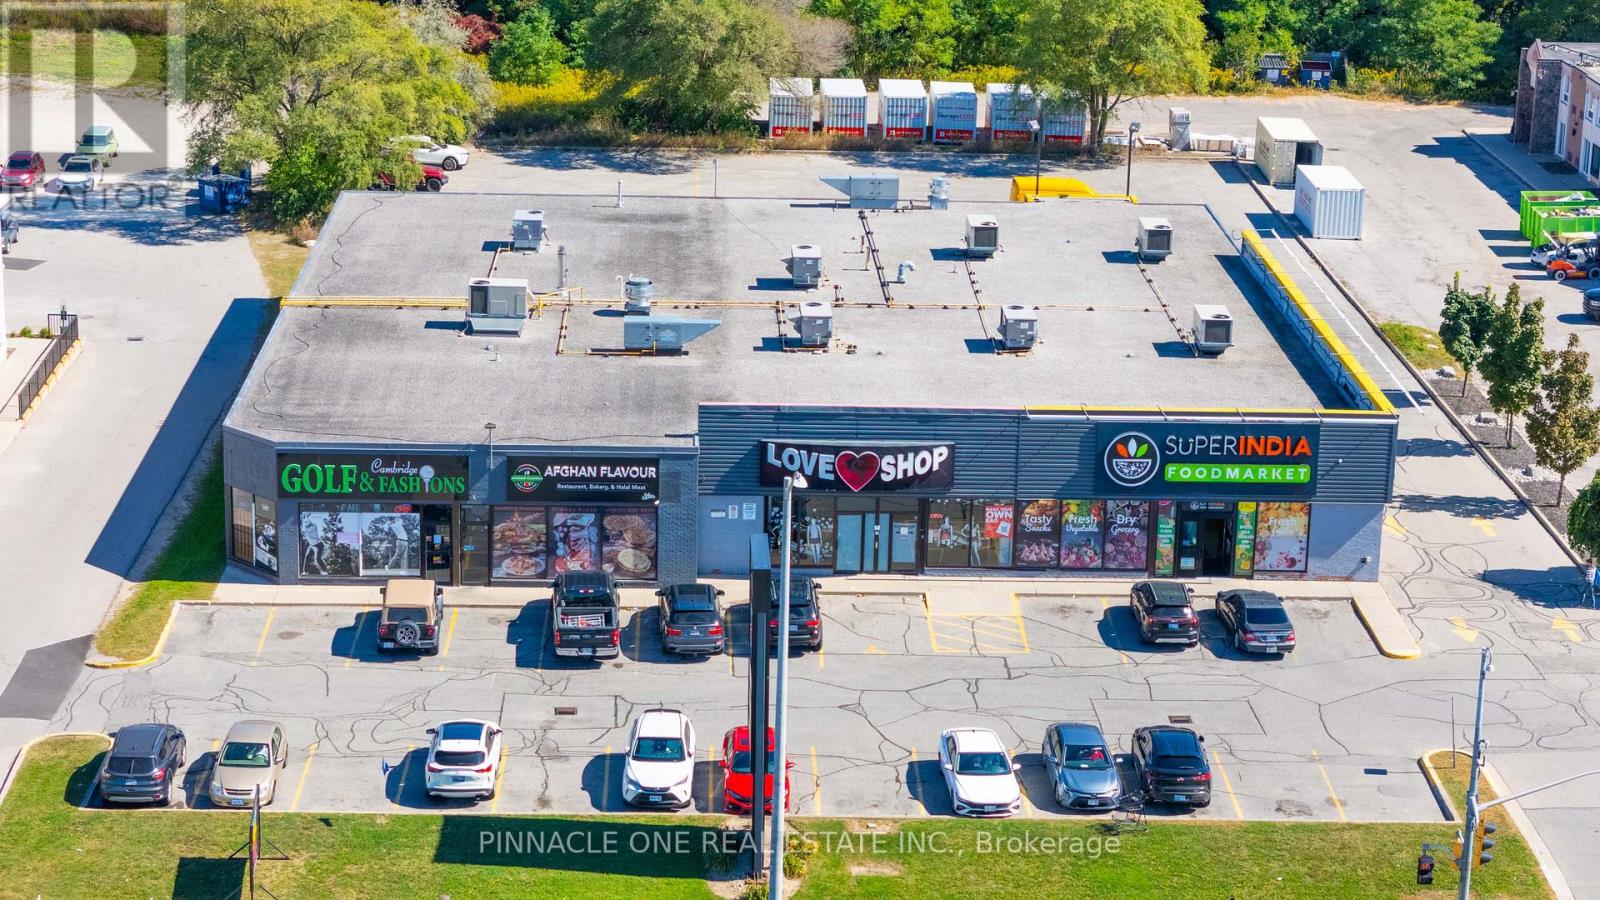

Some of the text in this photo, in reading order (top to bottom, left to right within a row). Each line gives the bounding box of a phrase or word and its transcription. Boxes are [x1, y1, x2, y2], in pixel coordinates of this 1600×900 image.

[371, 458, 418, 475] Cambridge
[767, 443, 949, 482] LOVE SHOP
[544, 465, 657, 478] AFGHAN FLAVOUR
[281, 463, 357, 494] GOLF
[360, 471, 375, 492] &
[985, 511, 1013, 519] OWN
[1025, 515, 1053, 526] Tasty
[1068, 514, 1098, 524] Fresh
[1116, 515, 1138, 526] Dry
[1025, 524, 1052, 532] Snacks
[1066, 524, 1099, 535] Vegetable
[1110, 525, 1141, 536] Grocery
